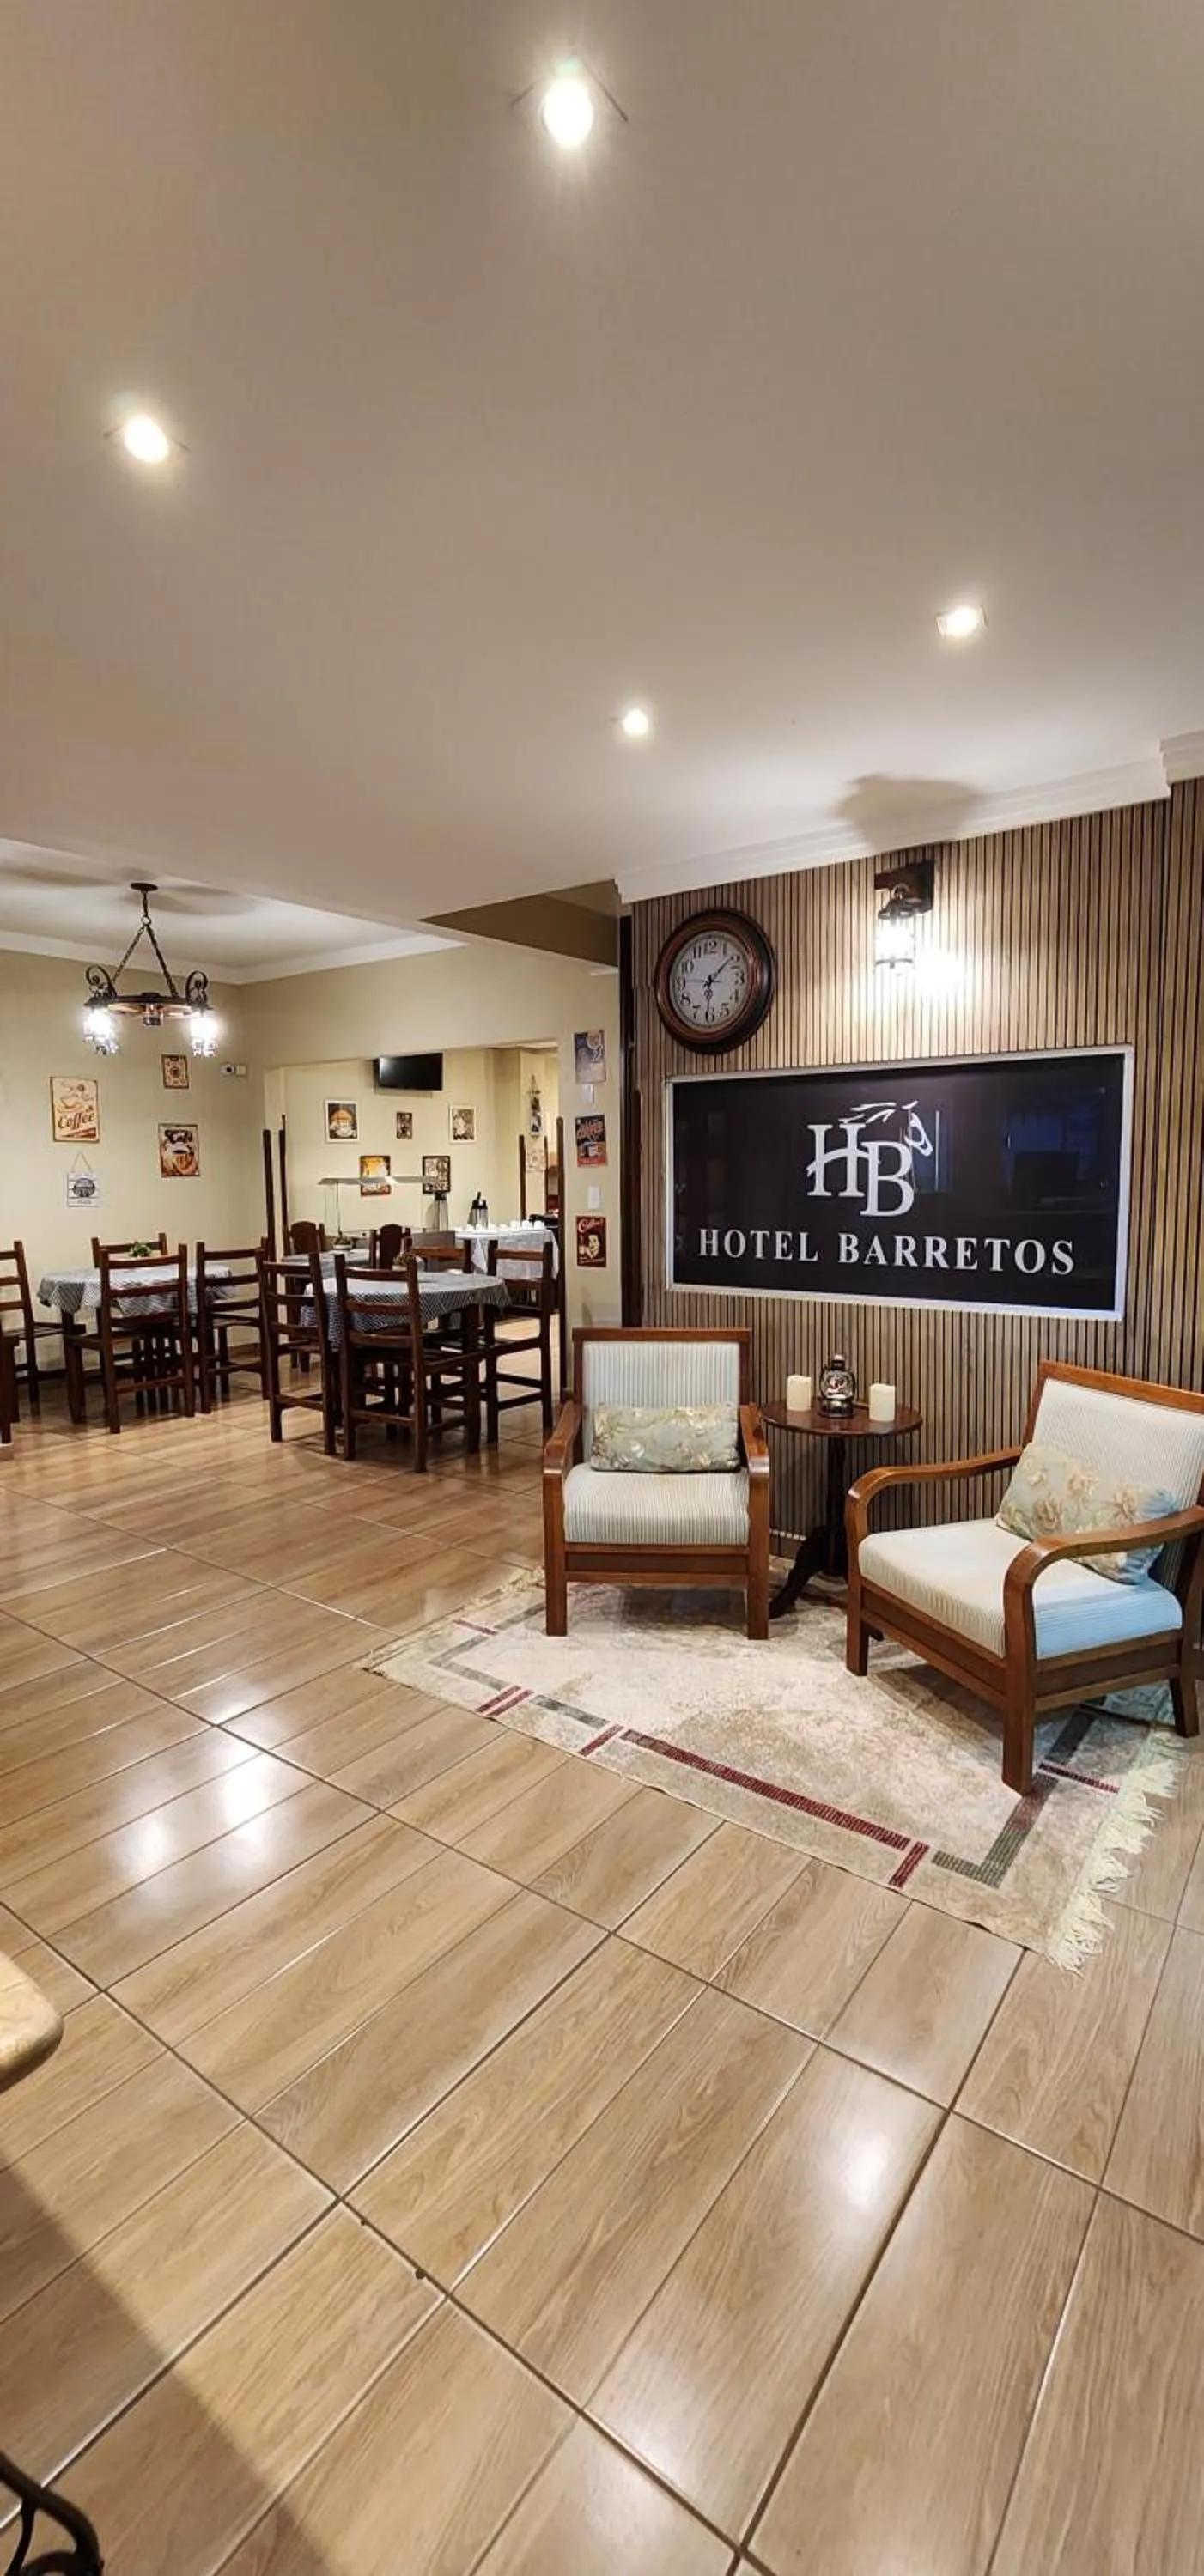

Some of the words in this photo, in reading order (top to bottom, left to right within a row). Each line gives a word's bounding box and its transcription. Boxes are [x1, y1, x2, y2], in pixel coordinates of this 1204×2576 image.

[692, 945, 702, 959] 11
[704, 940, 717, 955] 12
[722, 941, 727, 957] 1
[681, 959, 695, 975] 10
[730, 954, 741, 970] 2
[676, 976, 686, 992] 9
[733, 969, 745, 986] 3
[680, 992, 691, 1006] 8
[728, 988, 739, 1004] 4
[692, 1003, 702, 1020] 7
[705, 1006, 715, 1024] 6
[719, 1002, 730, 1018] 5
[58, 1112, 95, 1130] Coffee
[806, 1122, 915, 1217] HB
[698, 1229, 818, 1262] HOTEL
[838, 1232, 1074, 1276] BARRETOS
